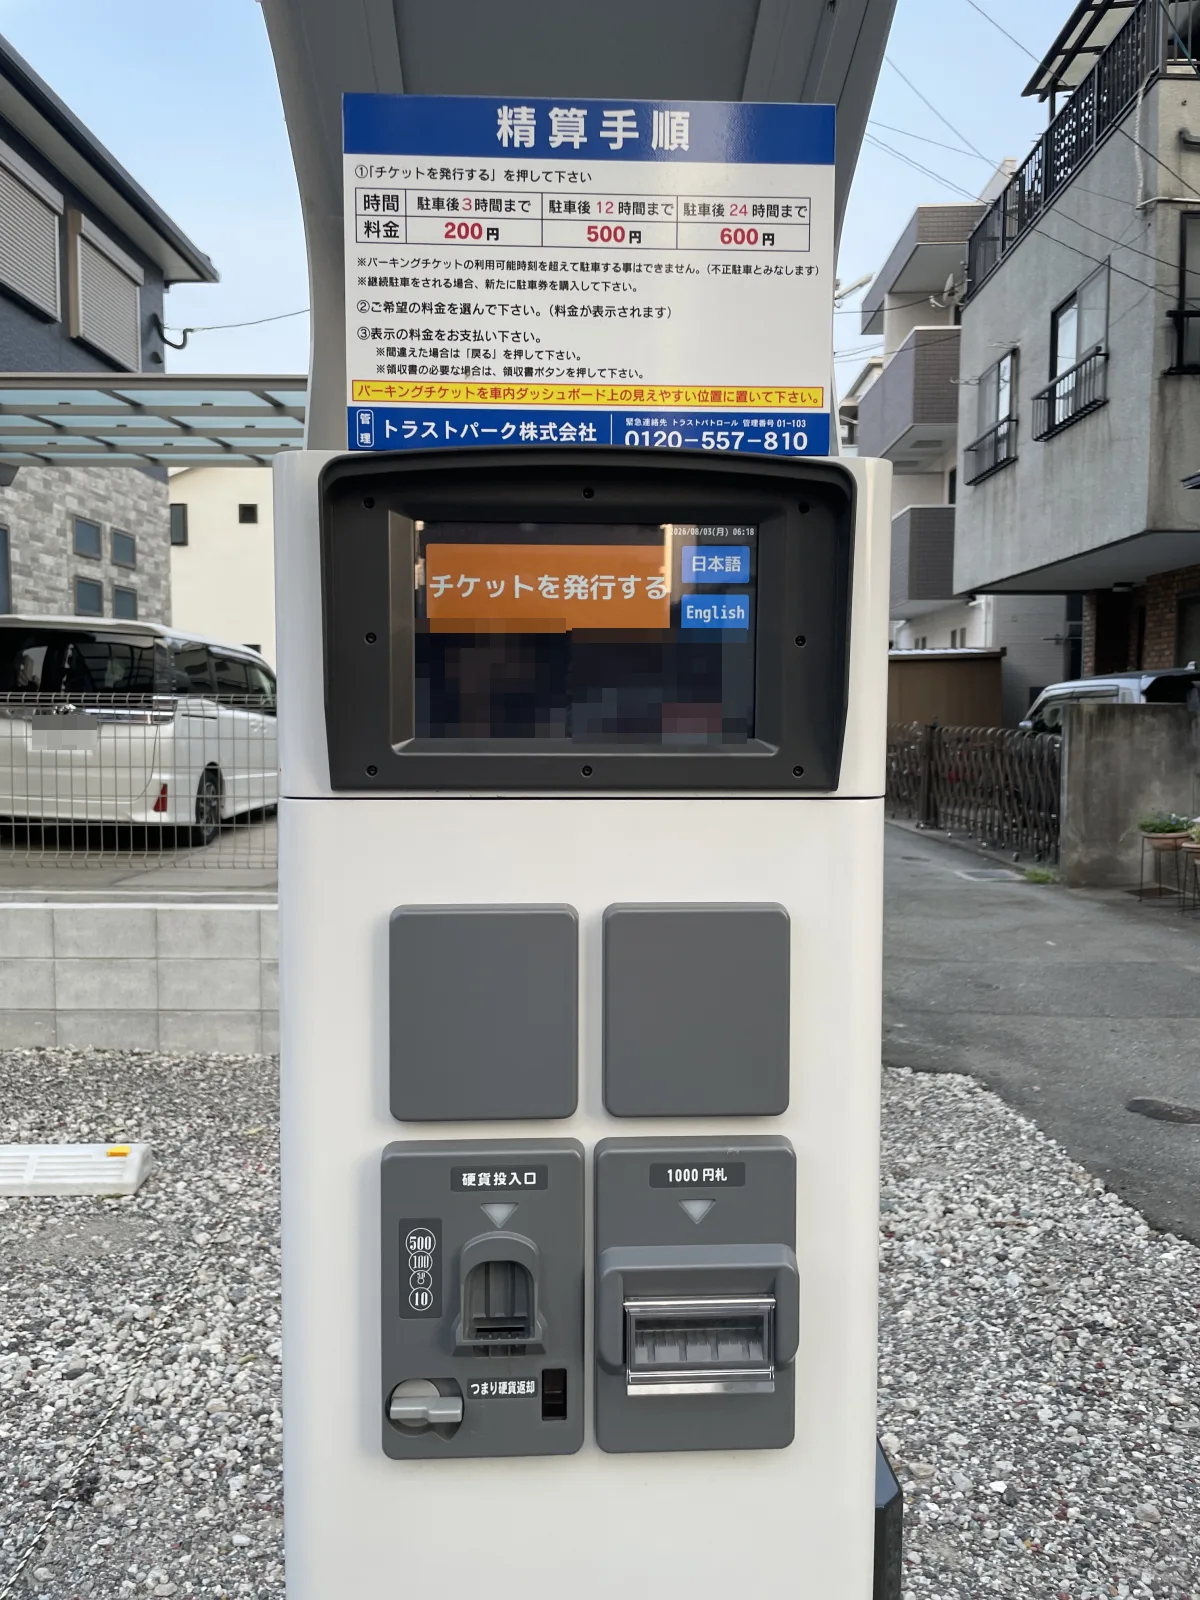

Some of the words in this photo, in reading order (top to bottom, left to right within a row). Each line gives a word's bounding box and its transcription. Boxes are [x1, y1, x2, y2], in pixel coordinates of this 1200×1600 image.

[496, 105, 690, 151] 精算手順
[363, 194, 400, 212] 時間
[417, 197, 532, 213] 駐車後3時間まで
[363, 220, 400, 239] 料金
[444, 222, 500, 241] 200円
[586, 225, 642, 244] 500円
[720, 227, 775, 247] 600円
[357, 327, 542, 344] ③表示の料金をお支払い下さい。
[376, 347, 582, 361] ※間違えた場合は「戻る」を押して下さい。
[376, 364, 644, 380] ※領収書の必要な場合は、領収書ボタンを押して下さい。
[358, 384, 819, 404] パーキングチケットを車内ダッシュボード上の見えやすい位置に置いて下さい。
[359, 412, 372, 445] 管理
[385, 419, 597, 442] トラストパーク株式会社
[625, 417, 668, 427] 緊急連絡先
[672, 418, 739, 428] トラストパトロール
[742, 419, 775, 428] 管理番号
[776, 419, 807, 428] 01-103
[624, 430, 808, 451] 0120-557-810
[732, 527, 755, 536] 06:18
[691, 555, 742, 573] 日本語
[429, 573, 668, 601] チケットを発行する
[686, 605, 745, 623] English
[462, 1172, 537, 1187] 硬貨投入口
[409, 1235, 432, 1251] 500
[412, 1254, 430, 1269] 100
[414, 1291, 428, 1306] 10
[470, 1380, 536, 1397] つまり硬貨返却
